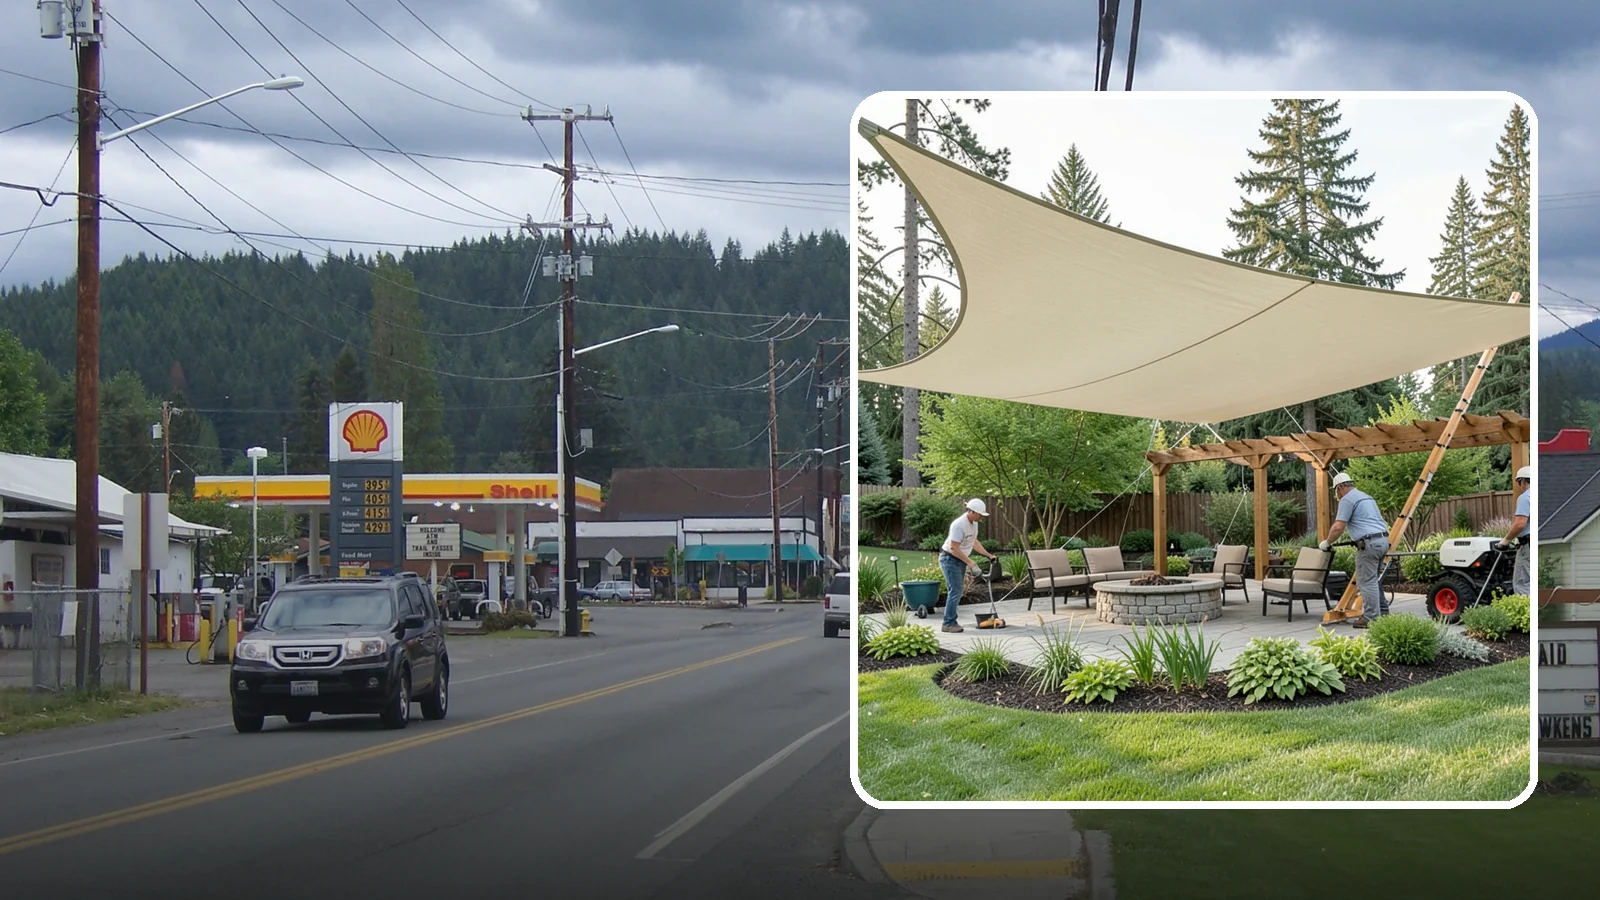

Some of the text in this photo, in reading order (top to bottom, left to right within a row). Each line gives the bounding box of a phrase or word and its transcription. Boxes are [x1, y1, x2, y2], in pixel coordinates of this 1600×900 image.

[365, 480, 383, 490] 395
[490, 485, 547, 499] Shell
[365, 494, 383, 504] 405
[365, 508, 383, 518] 415
[365, 522, 383, 533] 429
